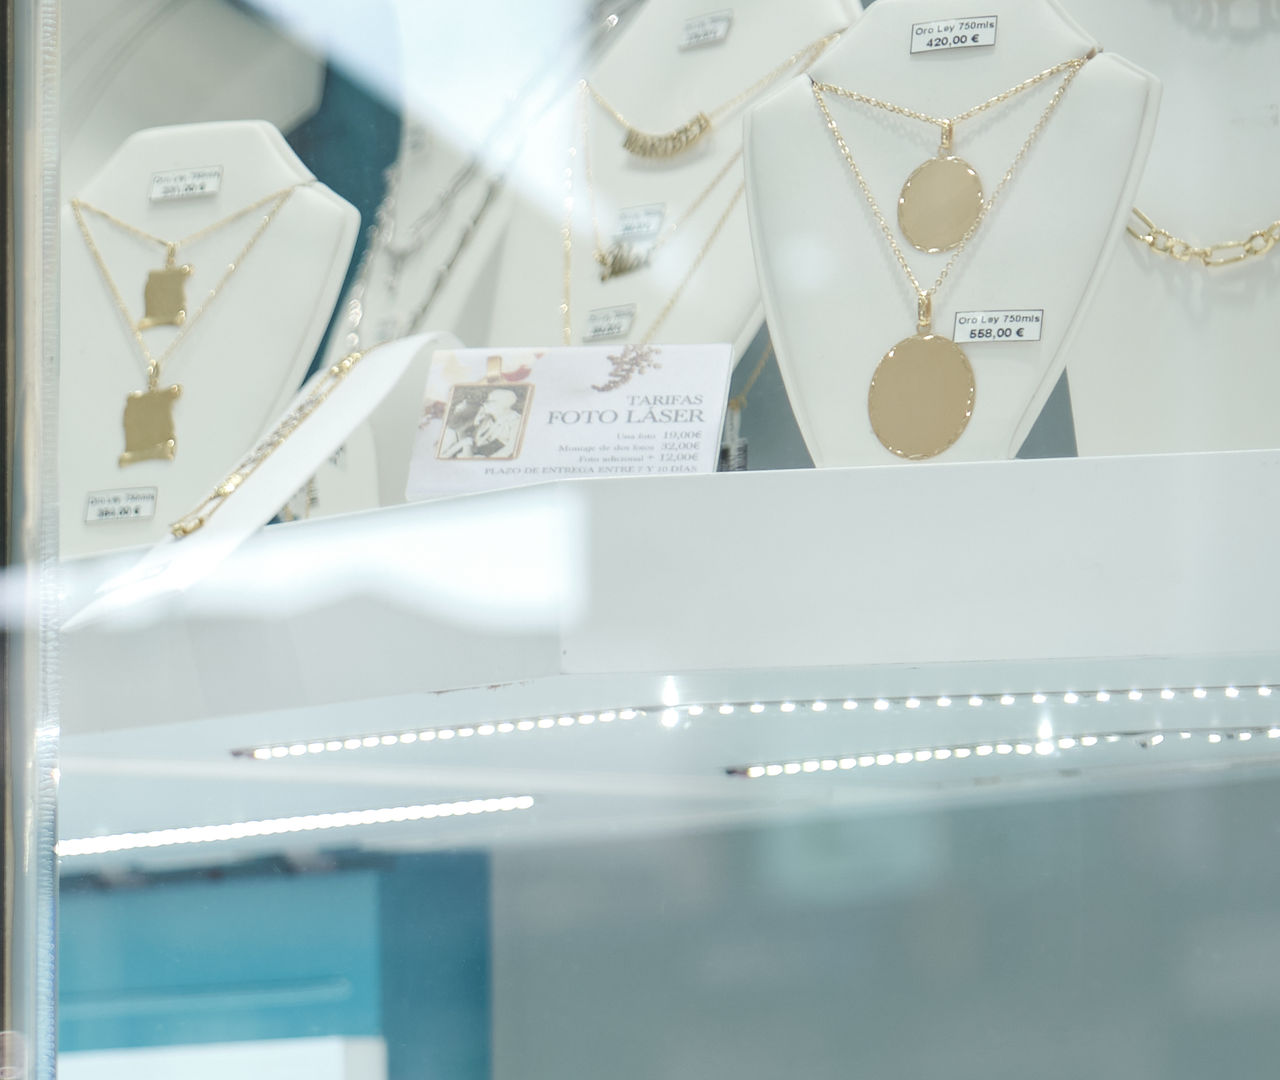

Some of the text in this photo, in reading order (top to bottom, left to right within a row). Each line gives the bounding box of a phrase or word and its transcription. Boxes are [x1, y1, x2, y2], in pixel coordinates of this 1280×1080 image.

[915, 20, 995, 36] Oro Ley 750mls
[926, 33, 980, 47] 420,00 €
[958, 314, 1041, 325] Oro Ley 750mls
[1016, 327, 1025, 338] €
[627, 394, 705, 407] TARIFAS
[547, 406, 705, 425] FOTO LÁSER
[485, 467, 521, 475] PLAZO
[524, 466, 538, 474] DE
[541, 466, 595, 474] ENTREGA
[598, 465, 633, 473] ENTRE
